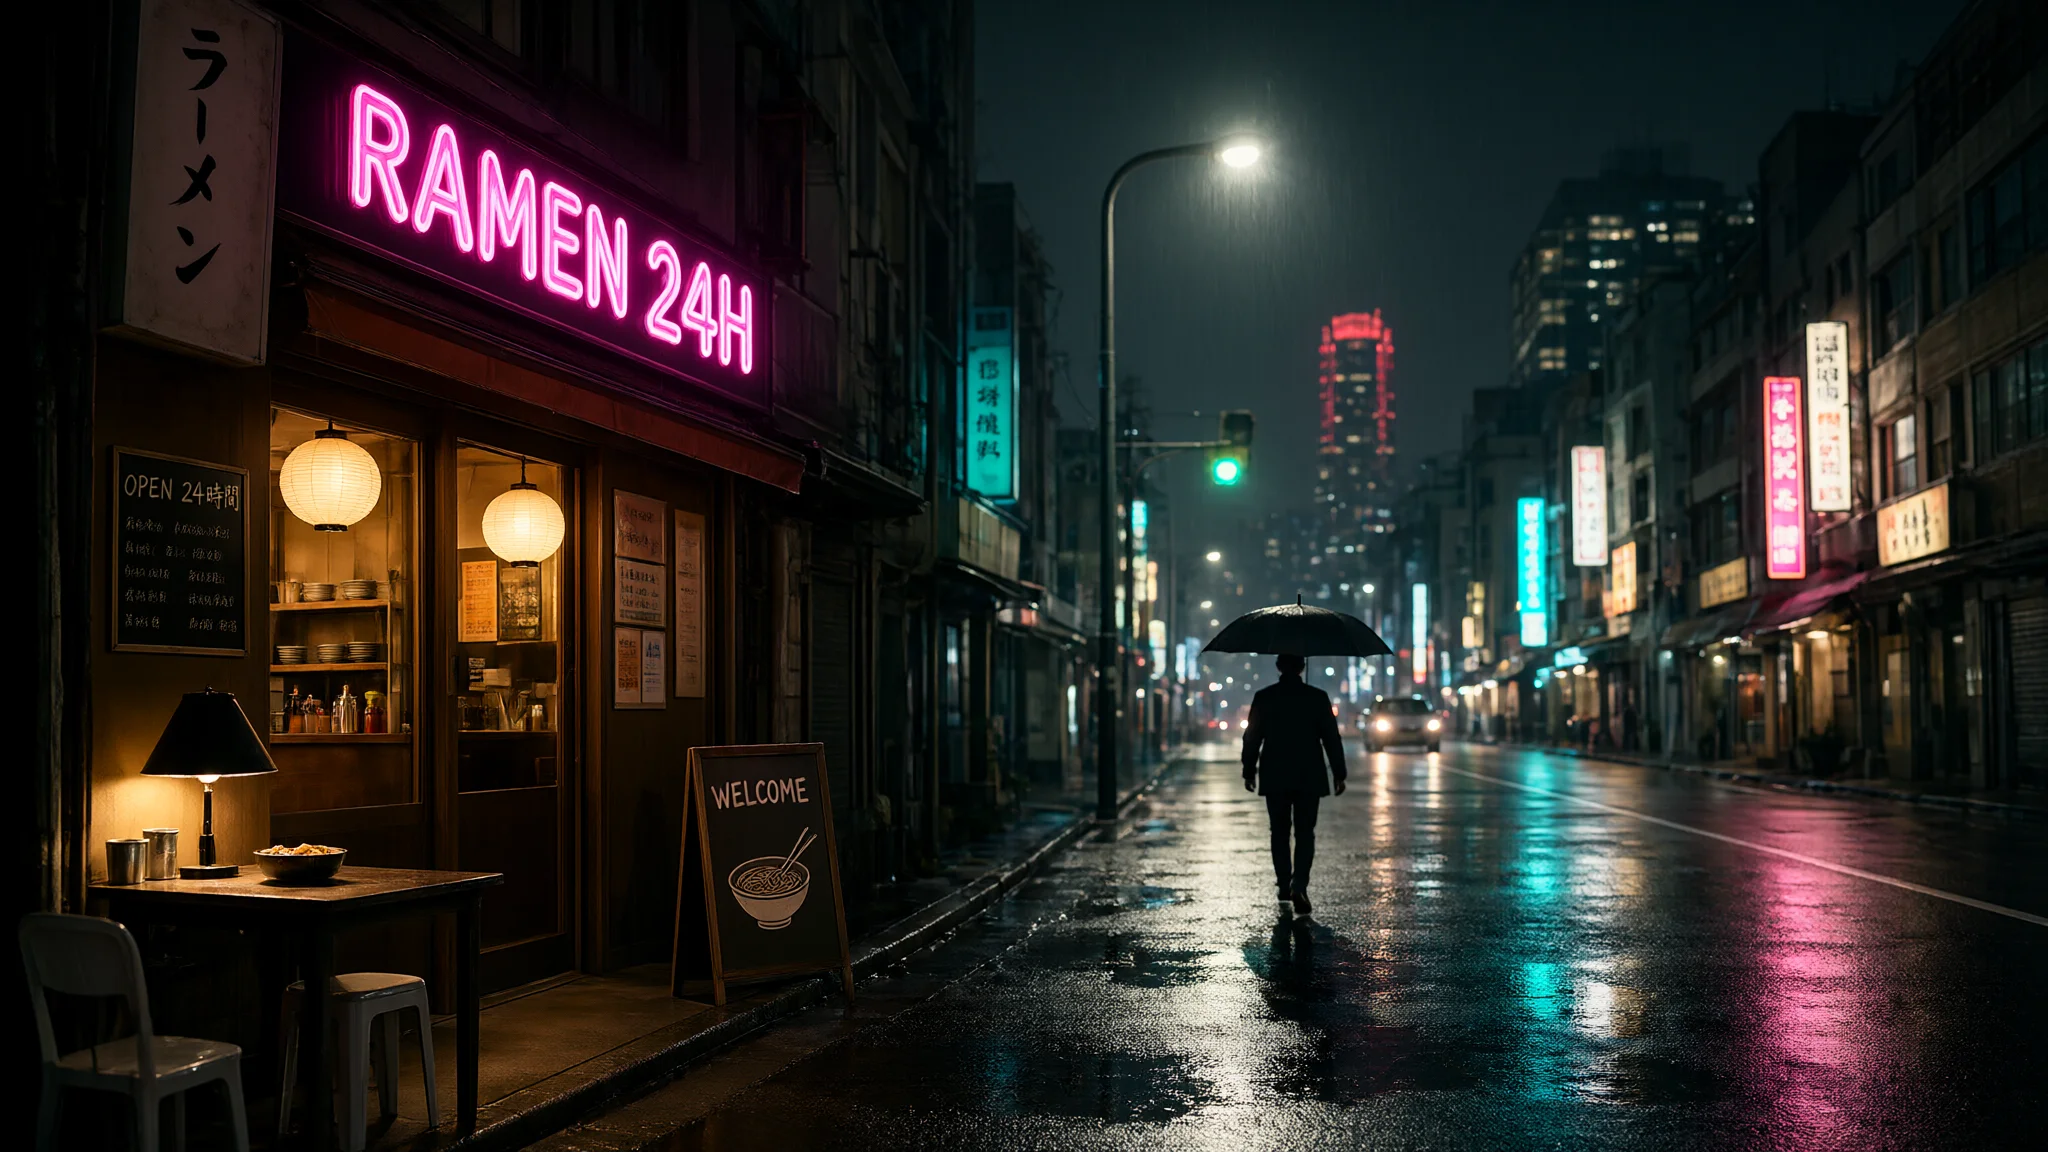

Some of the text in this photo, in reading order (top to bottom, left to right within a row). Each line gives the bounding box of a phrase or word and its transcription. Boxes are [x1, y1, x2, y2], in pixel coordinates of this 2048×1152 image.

[169, 28, 228, 284] ラーメン
[350, 84, 753, 374] RAMEN 24H
[124, 473, 240, 512] OPEN 24時間
[711, 777, 810, 810] WELCOME
